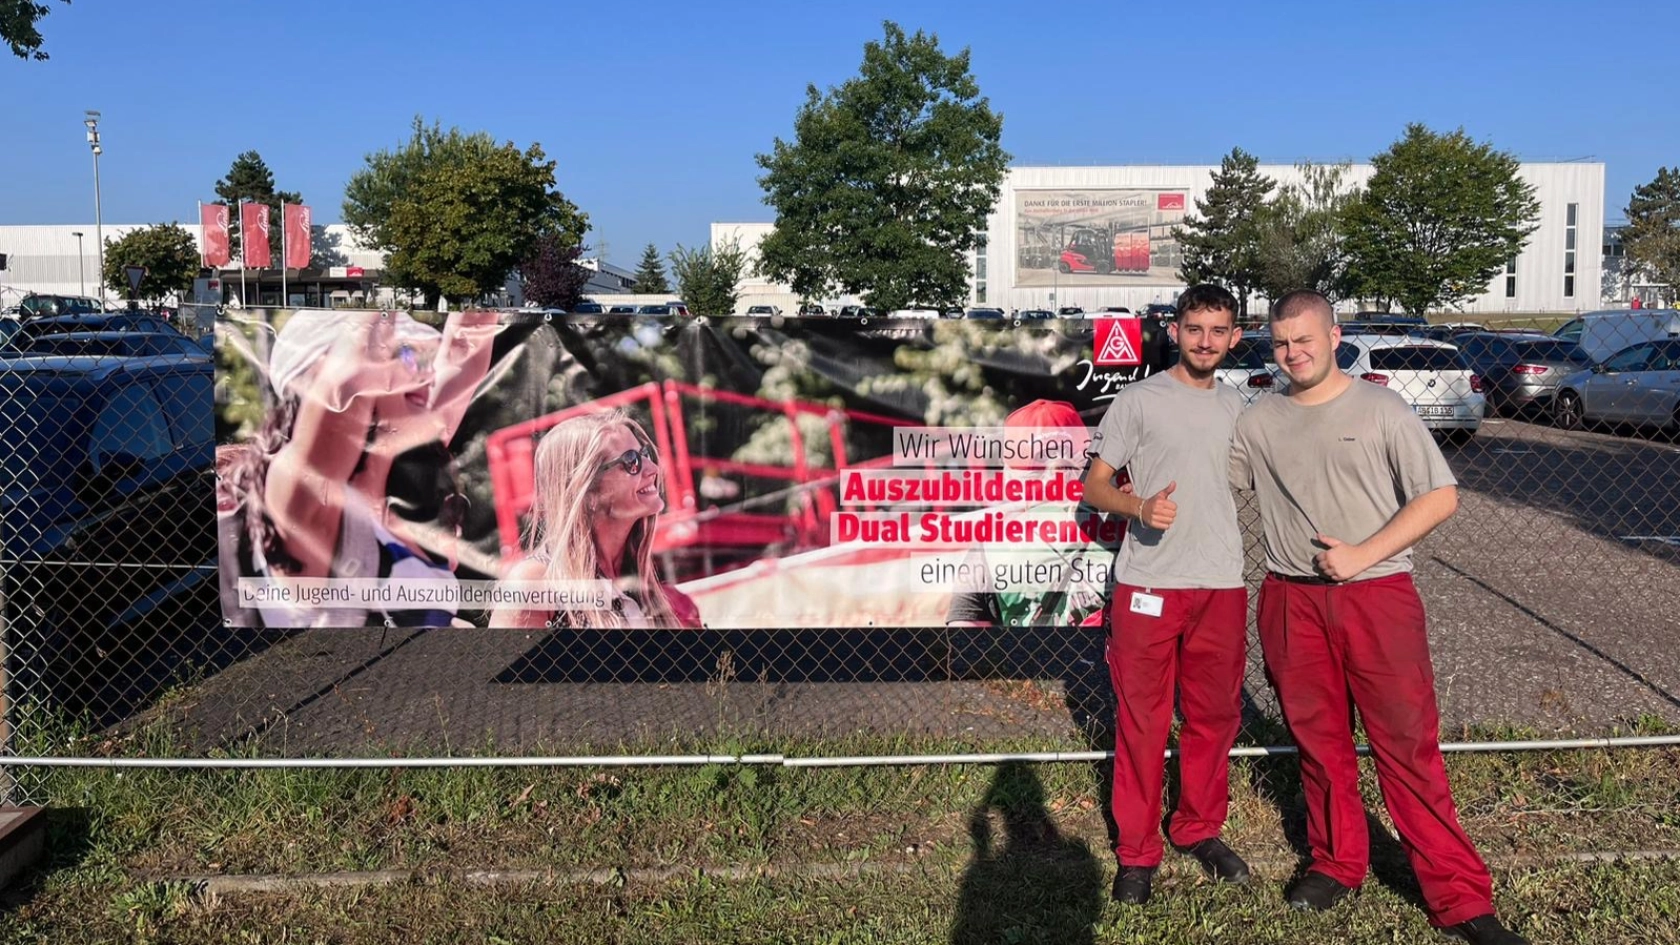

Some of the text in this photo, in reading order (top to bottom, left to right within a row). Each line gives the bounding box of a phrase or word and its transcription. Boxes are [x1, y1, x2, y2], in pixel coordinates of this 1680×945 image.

[1047, 199, 1059, 207] FÜR
[1061, 199, 1071, 207] DIE
[1072, 199, 1090, 207] ERSTE
[299, 207, 311, 240] Linde
[899, 433, 940, 459] Wir
[949, 433, 1073, 459] Wünschen
[843, 470, 1084, 502] Auszubildende
[838, 512, 911, 543] Dual
[920, 558, 986, 584] einen
[994, 560, 1061, 590] guten
[295, 584, 355, 605] Jugend-
[361, 585, 391, 601] und
[396, 585, 605, 607] Auszubildendenvertretung
